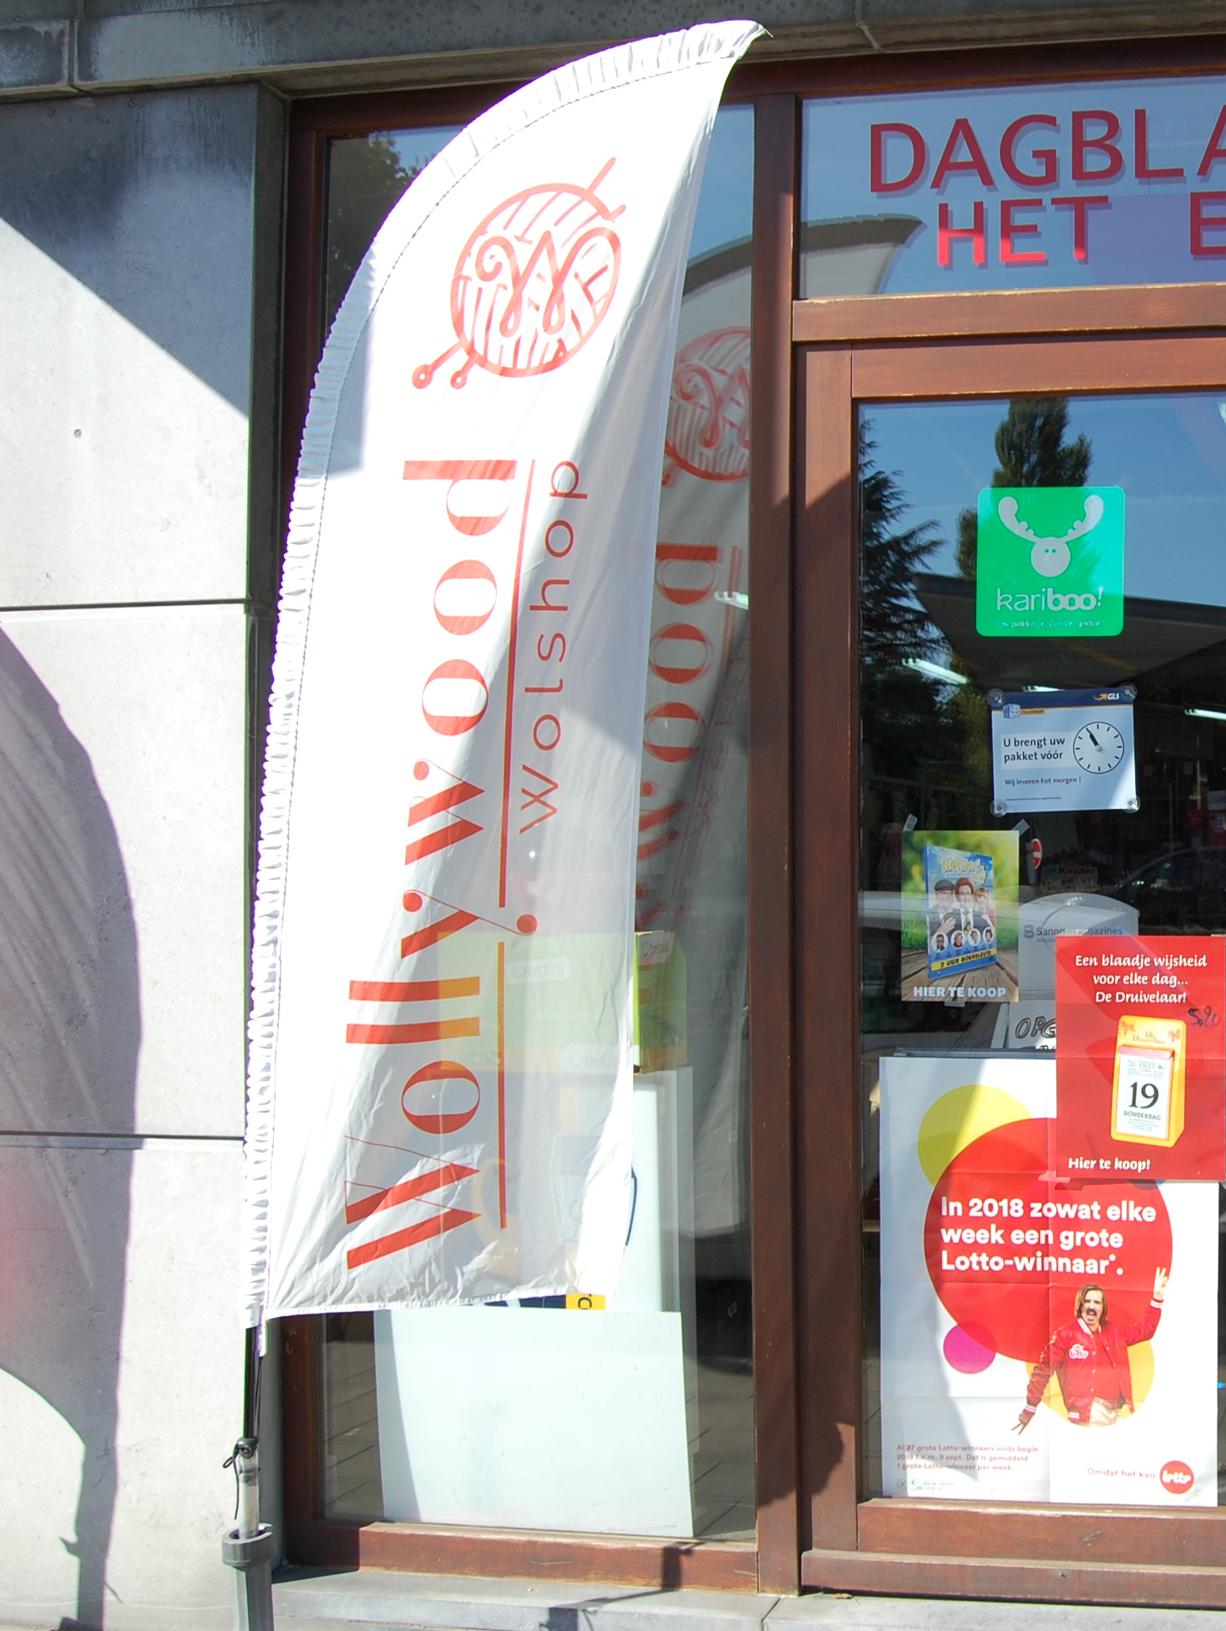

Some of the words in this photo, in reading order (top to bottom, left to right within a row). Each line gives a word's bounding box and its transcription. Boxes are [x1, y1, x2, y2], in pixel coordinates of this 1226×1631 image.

[937, 195, 1110, 266] HET
[997, 586, 1104, 611] kariboo!
[519, 461, 588, 834] Wolshop
[1107, 692, 1120, 700] GLS
[1003, 738, 1011, 747] U
[1013, 738, 1047, 749] brengt
[1049, 738, 1066, 746] uw
[1004, 751, 1038, 764] pakket
[1040, 750, 1063, 760] vóór
[1004, 778, 1016, 786] Wij
[344, 460, 537, 1270] Wollywood
[1075, 955, 1099, 967] Een
[1101, 954, 1151, 971] blaadje
[1154, 954, 1208, 971] wijsheid
[1093, 974, 1120, 985] voor
[1123, 972, 1149, 985] elke
[1151, 973, 1189, 989] dag...
[913, 986, 945, 997] HIER
[949, 986, 965, 997] TE
[967, 987, 1007, 997] KOOP
[1095, 991, 1113, 1003] De
[1115, 990, 1187, 1004] Druivelaar!
[1129, 1081, 1159, 1109] 19
[1068, 1157, 1097, 1170] Hier
[1099, 1158, 1111, 1170] te
[1114, 1157, 1151, 1173] koop!
[941, 1197, 963, 1217] In
[968, 1197, 1024, 1218] 2018
[1029, 1200, 1101, 1221] zowat
[1106, 1200, 1157, 1222] elke
[940, 1224, 1005, 1245] week
[1010, 1229, 1054, 1245] een
[1060, 1229, 1124, 1252] grote
[1087, 1468, 1118, 1477] Omdat
[1121, 1469, 1136, 1477] het
